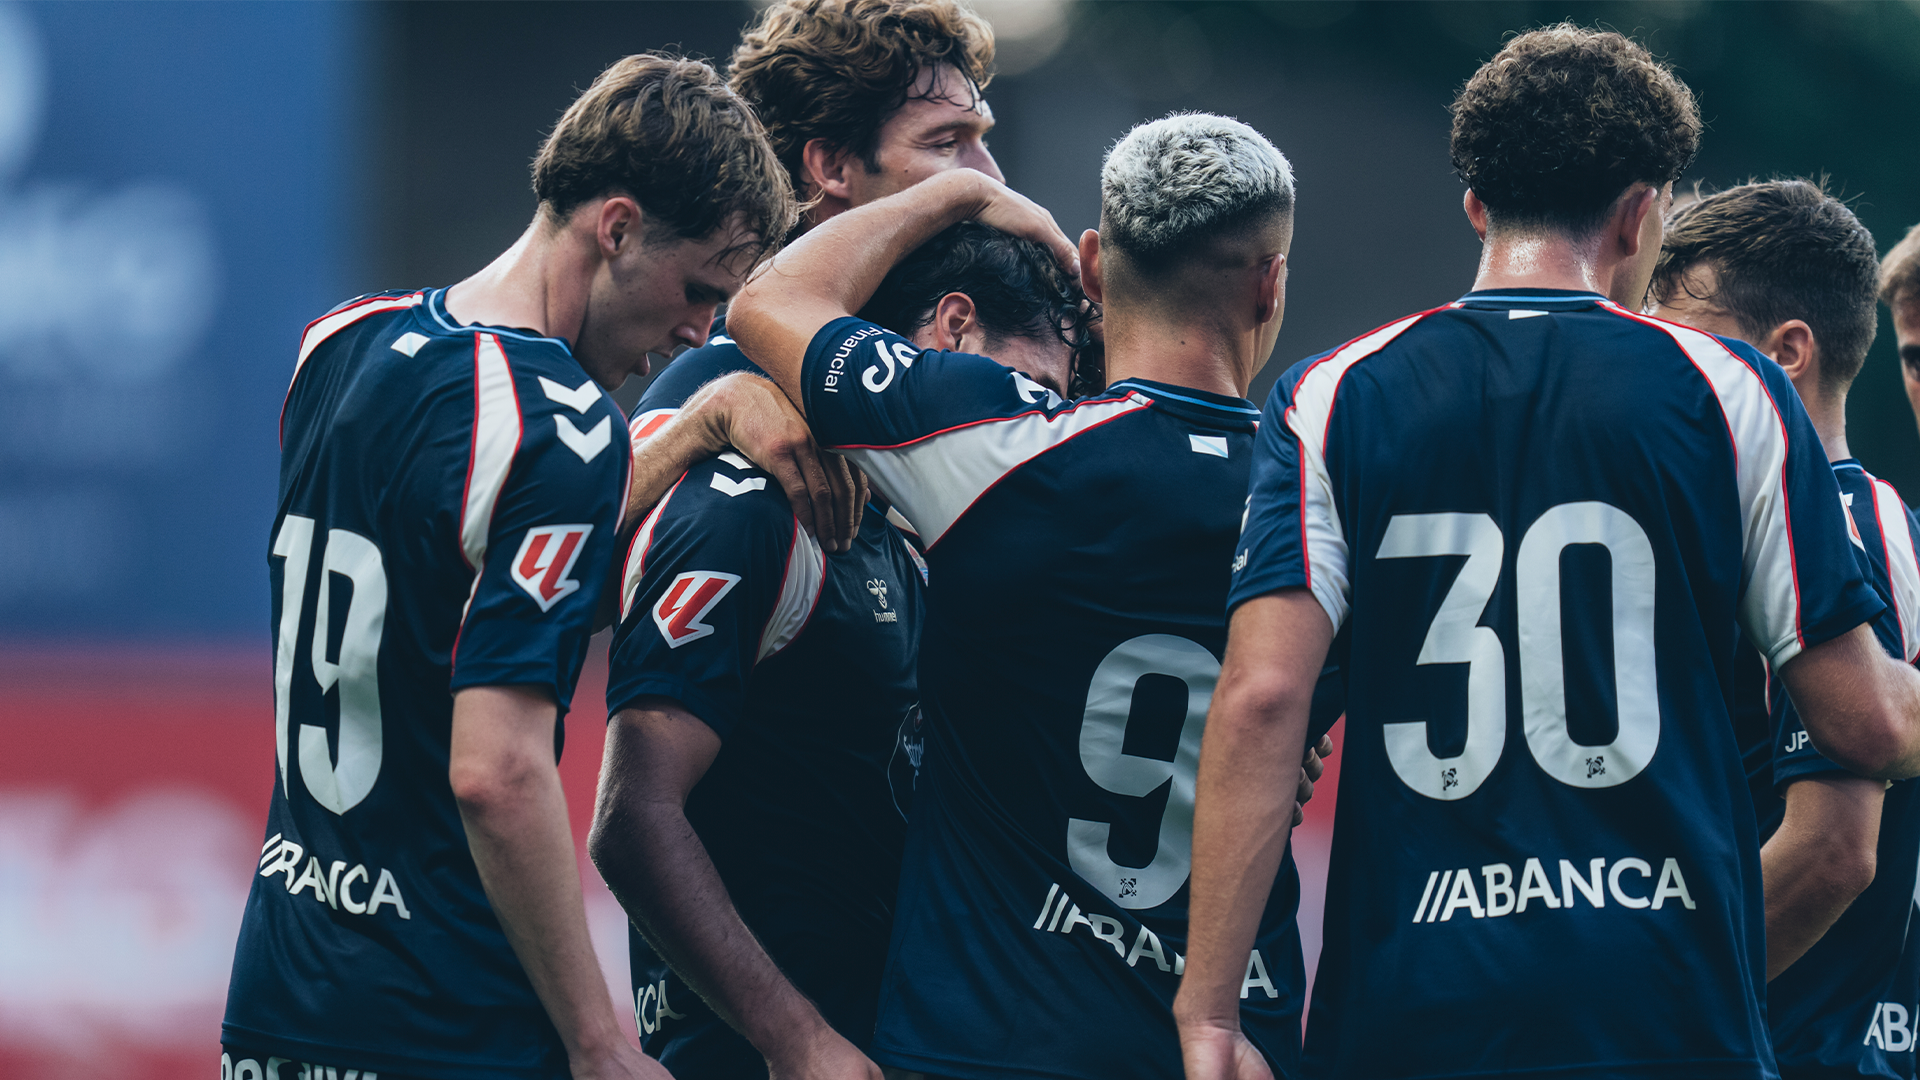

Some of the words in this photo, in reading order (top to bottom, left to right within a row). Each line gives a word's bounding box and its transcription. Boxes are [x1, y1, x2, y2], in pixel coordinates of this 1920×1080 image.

[823, 326, 884, 393] Financial
[272, 513, 388, 817] 19
[1066, 633, 1223, 910] 9
[1375, 500, 1661, 801] 30
[1437, 856, 1698, 924] ABANCA
